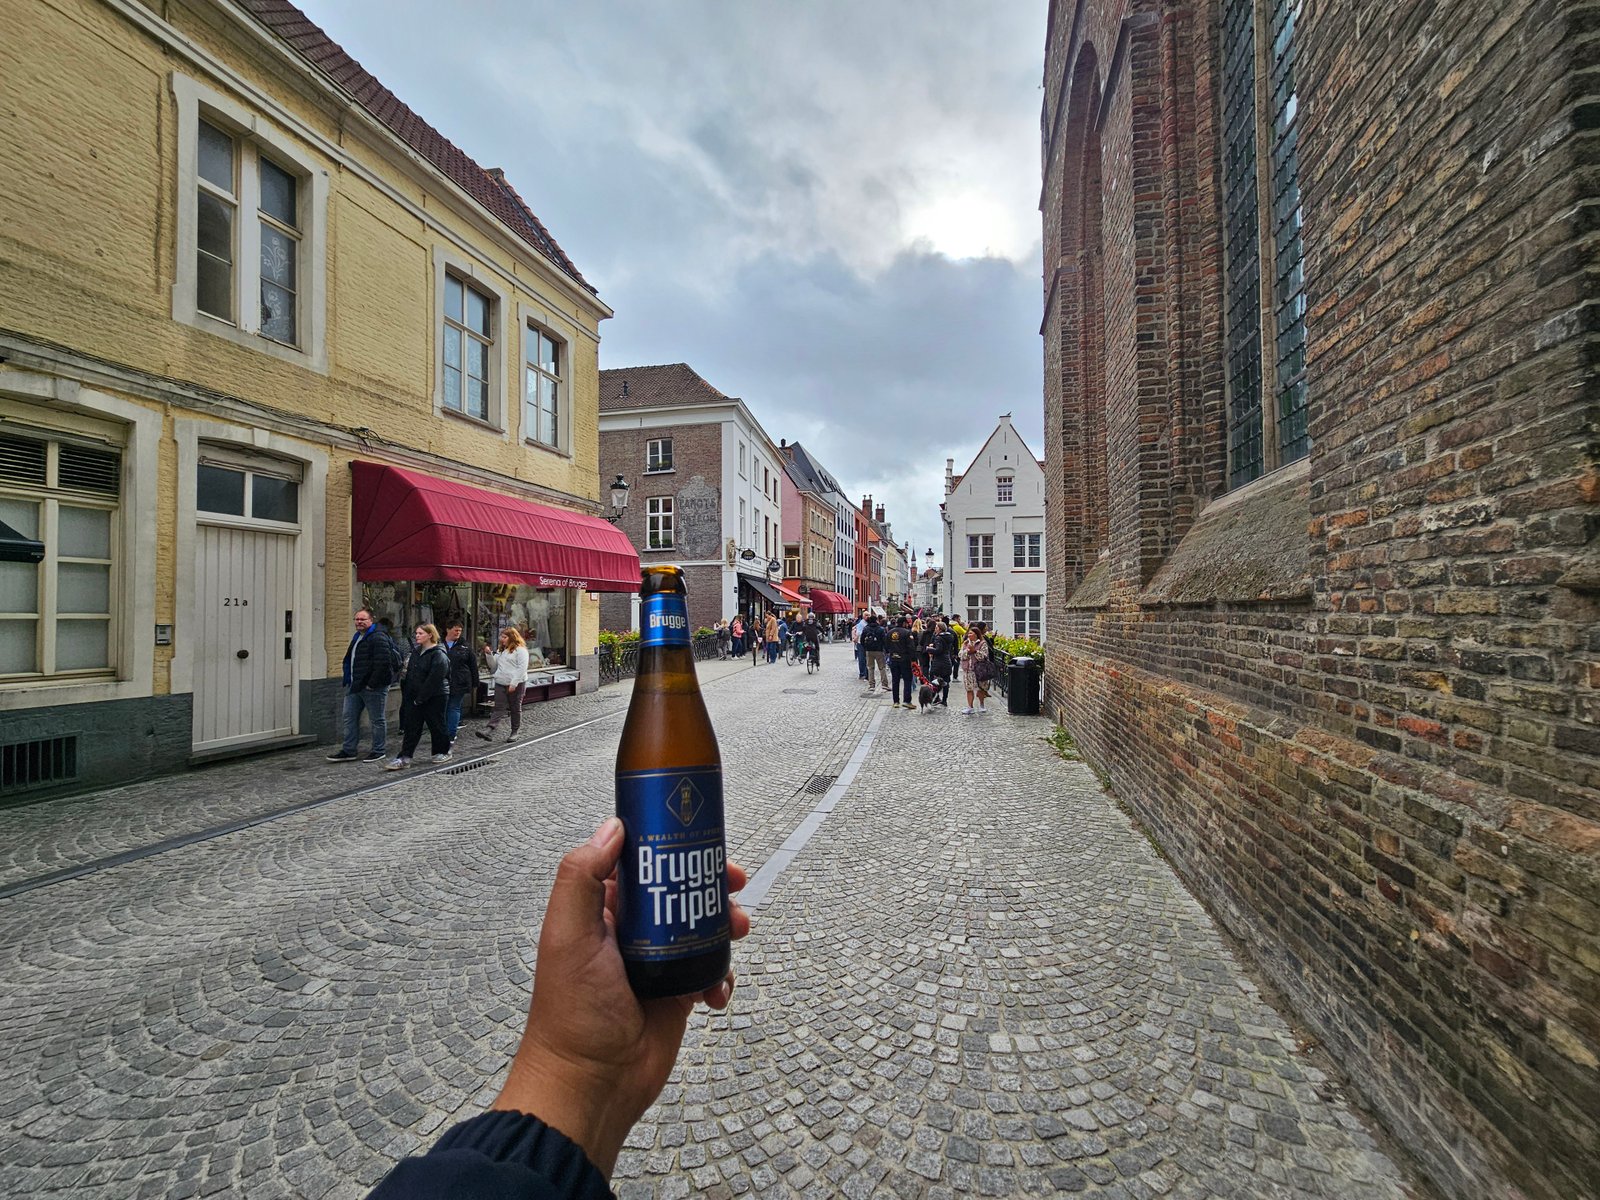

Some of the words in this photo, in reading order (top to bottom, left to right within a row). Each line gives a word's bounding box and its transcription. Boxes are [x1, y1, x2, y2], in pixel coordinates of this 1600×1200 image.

[539, 575, 562, 587] Serena
[562, 578, 569, 587] of
[568, 578, 588, 590] Bruges
[649, 613, 686, 629] Brugge
[646, 832, 685, 842] WEALTH
[638, 845, 724, 888] Brugge
[647, 877, 722, 930] Tripel
